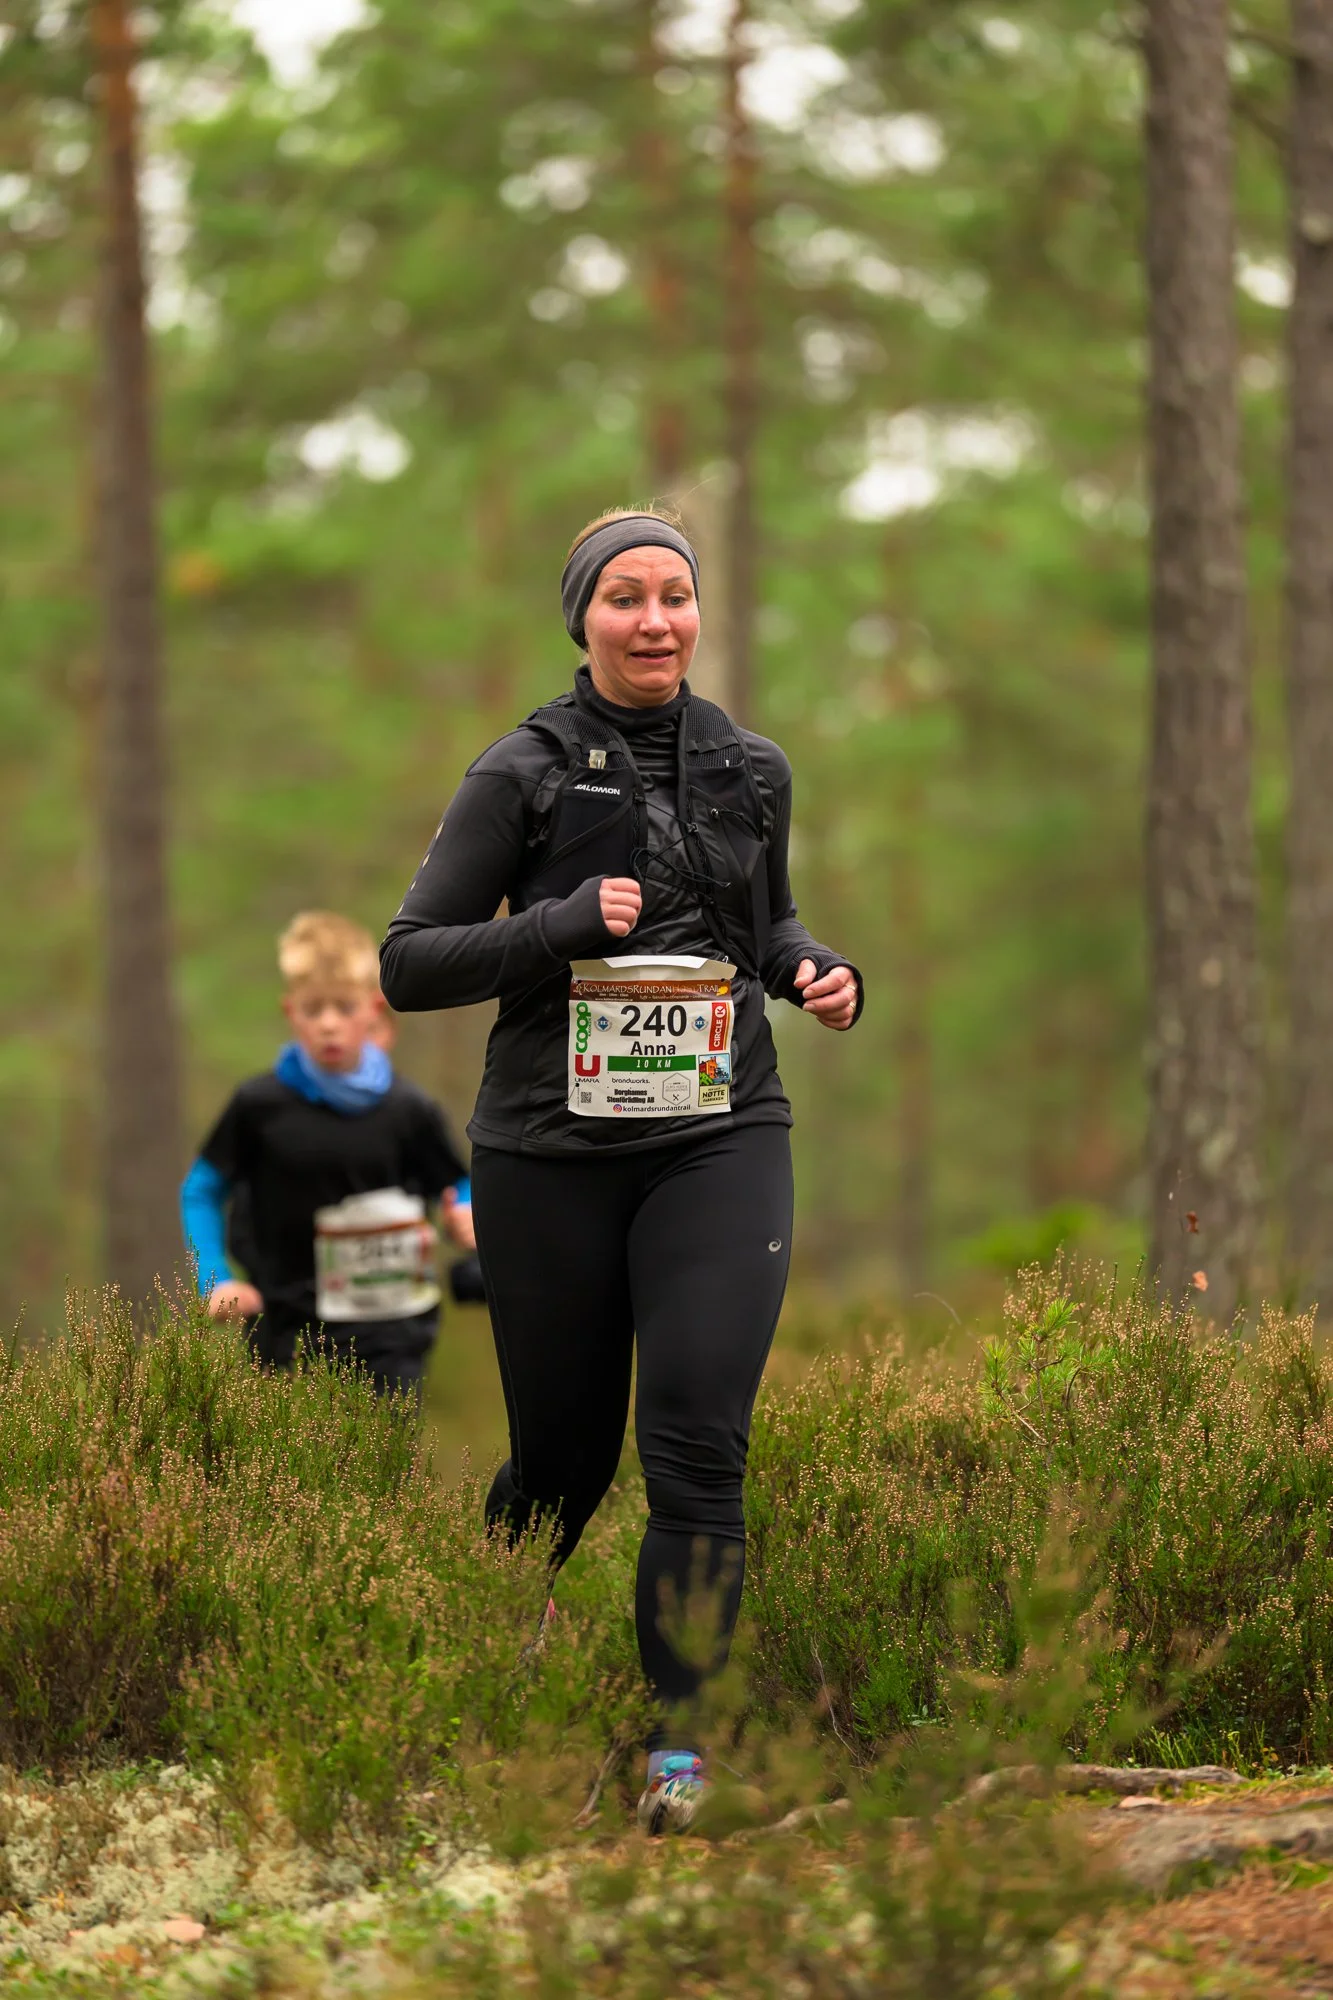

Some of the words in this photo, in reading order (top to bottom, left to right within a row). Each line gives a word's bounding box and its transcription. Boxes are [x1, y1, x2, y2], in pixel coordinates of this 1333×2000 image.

[574, 784, 620, 795] SALOMON
[576, 1002, 591, 1053] coop
[620, 1005, 687, 1037] 240
[714, 1019, 723, 1047] CIRCLE
[630, 1041, 676, 1056] Anna
[636, 1060, 650, 1068] 10
[657, 1059, 672, 1068] KM
[622, 1104, 691, 1112] kolmardsrundantrail
